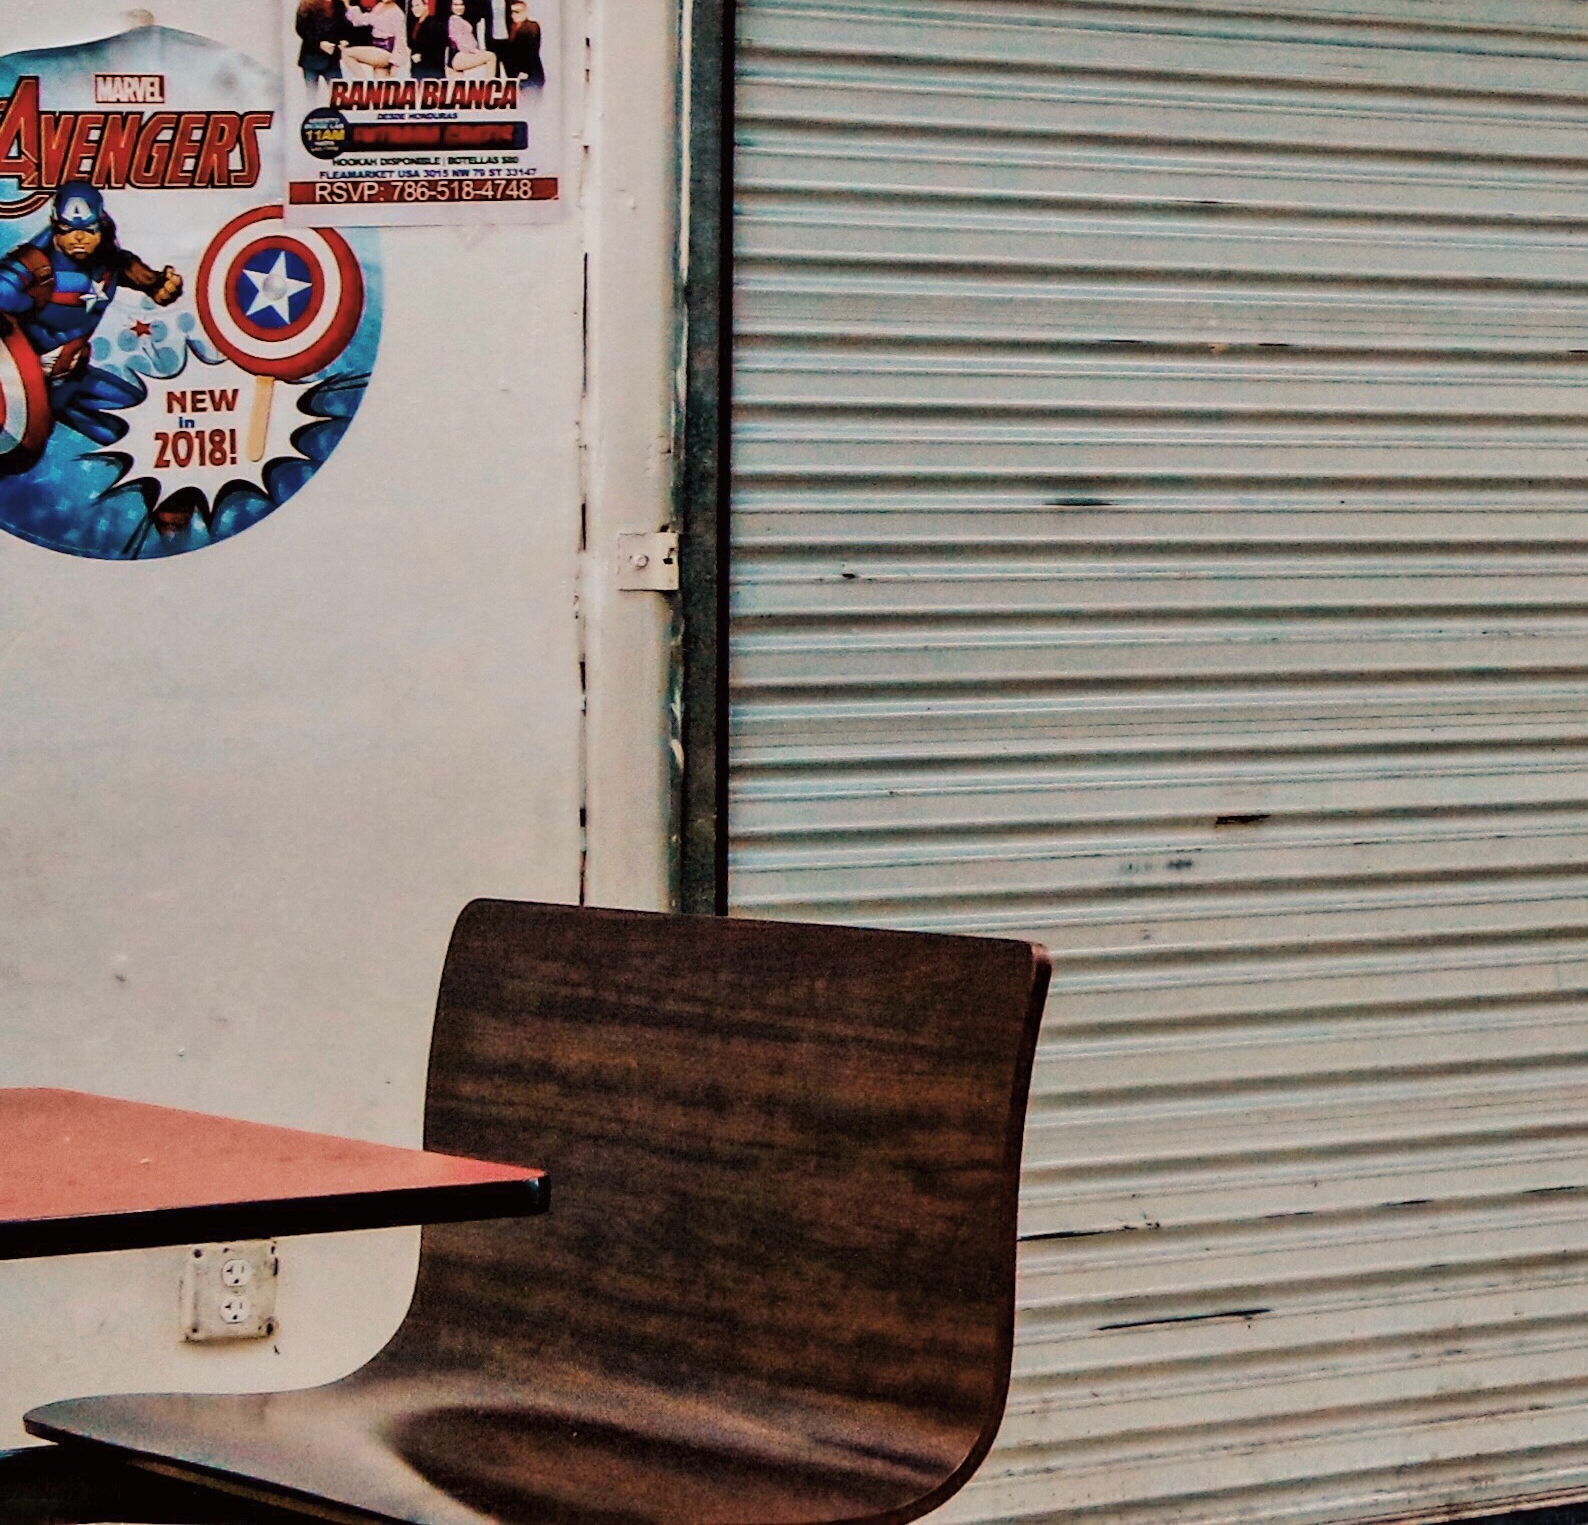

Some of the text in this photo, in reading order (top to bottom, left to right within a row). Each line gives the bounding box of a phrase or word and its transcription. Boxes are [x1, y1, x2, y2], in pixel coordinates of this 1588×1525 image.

[96, 75, 164, 103] MARVEL
[330, 79, 517, 111] BANDA BLANCA
[0, 75, 273, 189] AVENGERS
[319, 170, 395, 180] FLEAMARKET
[397, 169, 421, 178] USA
[489, 168, 502, 177] ST
[315, 179, 532, 203] RSVP: 786-518-4748
[166, 388, 239, 414] NEW
[178, 416, 195, 429] in
[153, 428, 238, 469] 2018!
